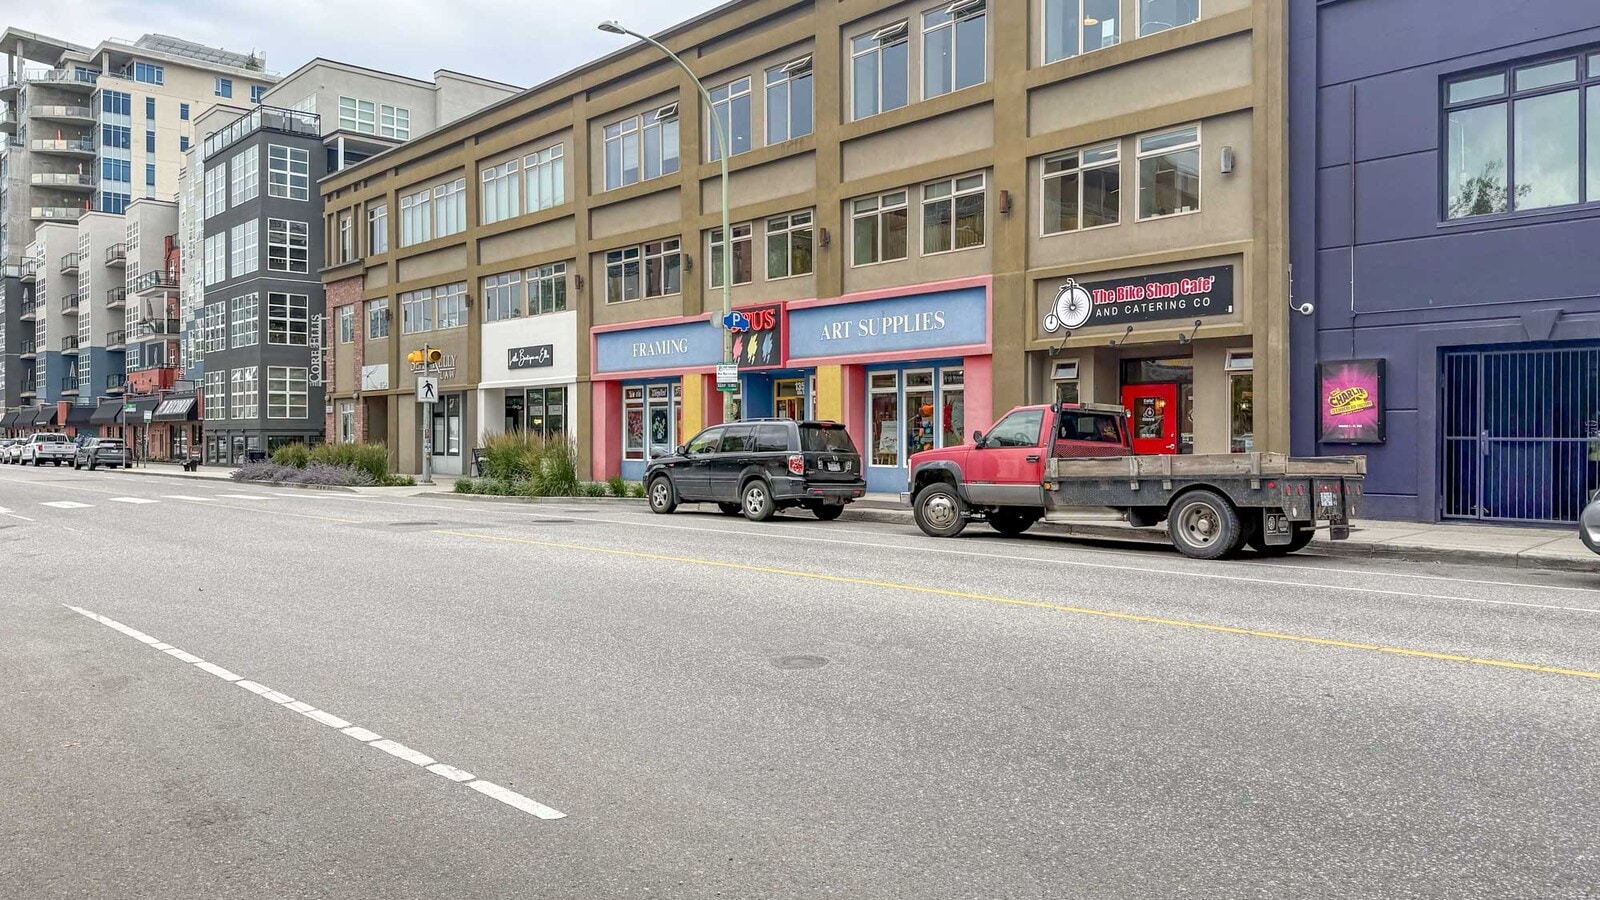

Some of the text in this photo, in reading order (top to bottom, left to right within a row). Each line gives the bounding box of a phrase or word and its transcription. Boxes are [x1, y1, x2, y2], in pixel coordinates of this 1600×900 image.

[1092, 289, 1114, 305] The
[1116, 285, 1143, 303] Bike
[1145, 282, 1177, 300] Shop
[1095, 297, 1211, 317] AND CATERING CO
[733, 313, 741, 326] P
[820, 310, 946, 341] ART SUPPLIES
[632, 338, 688, 358] FRAMING
